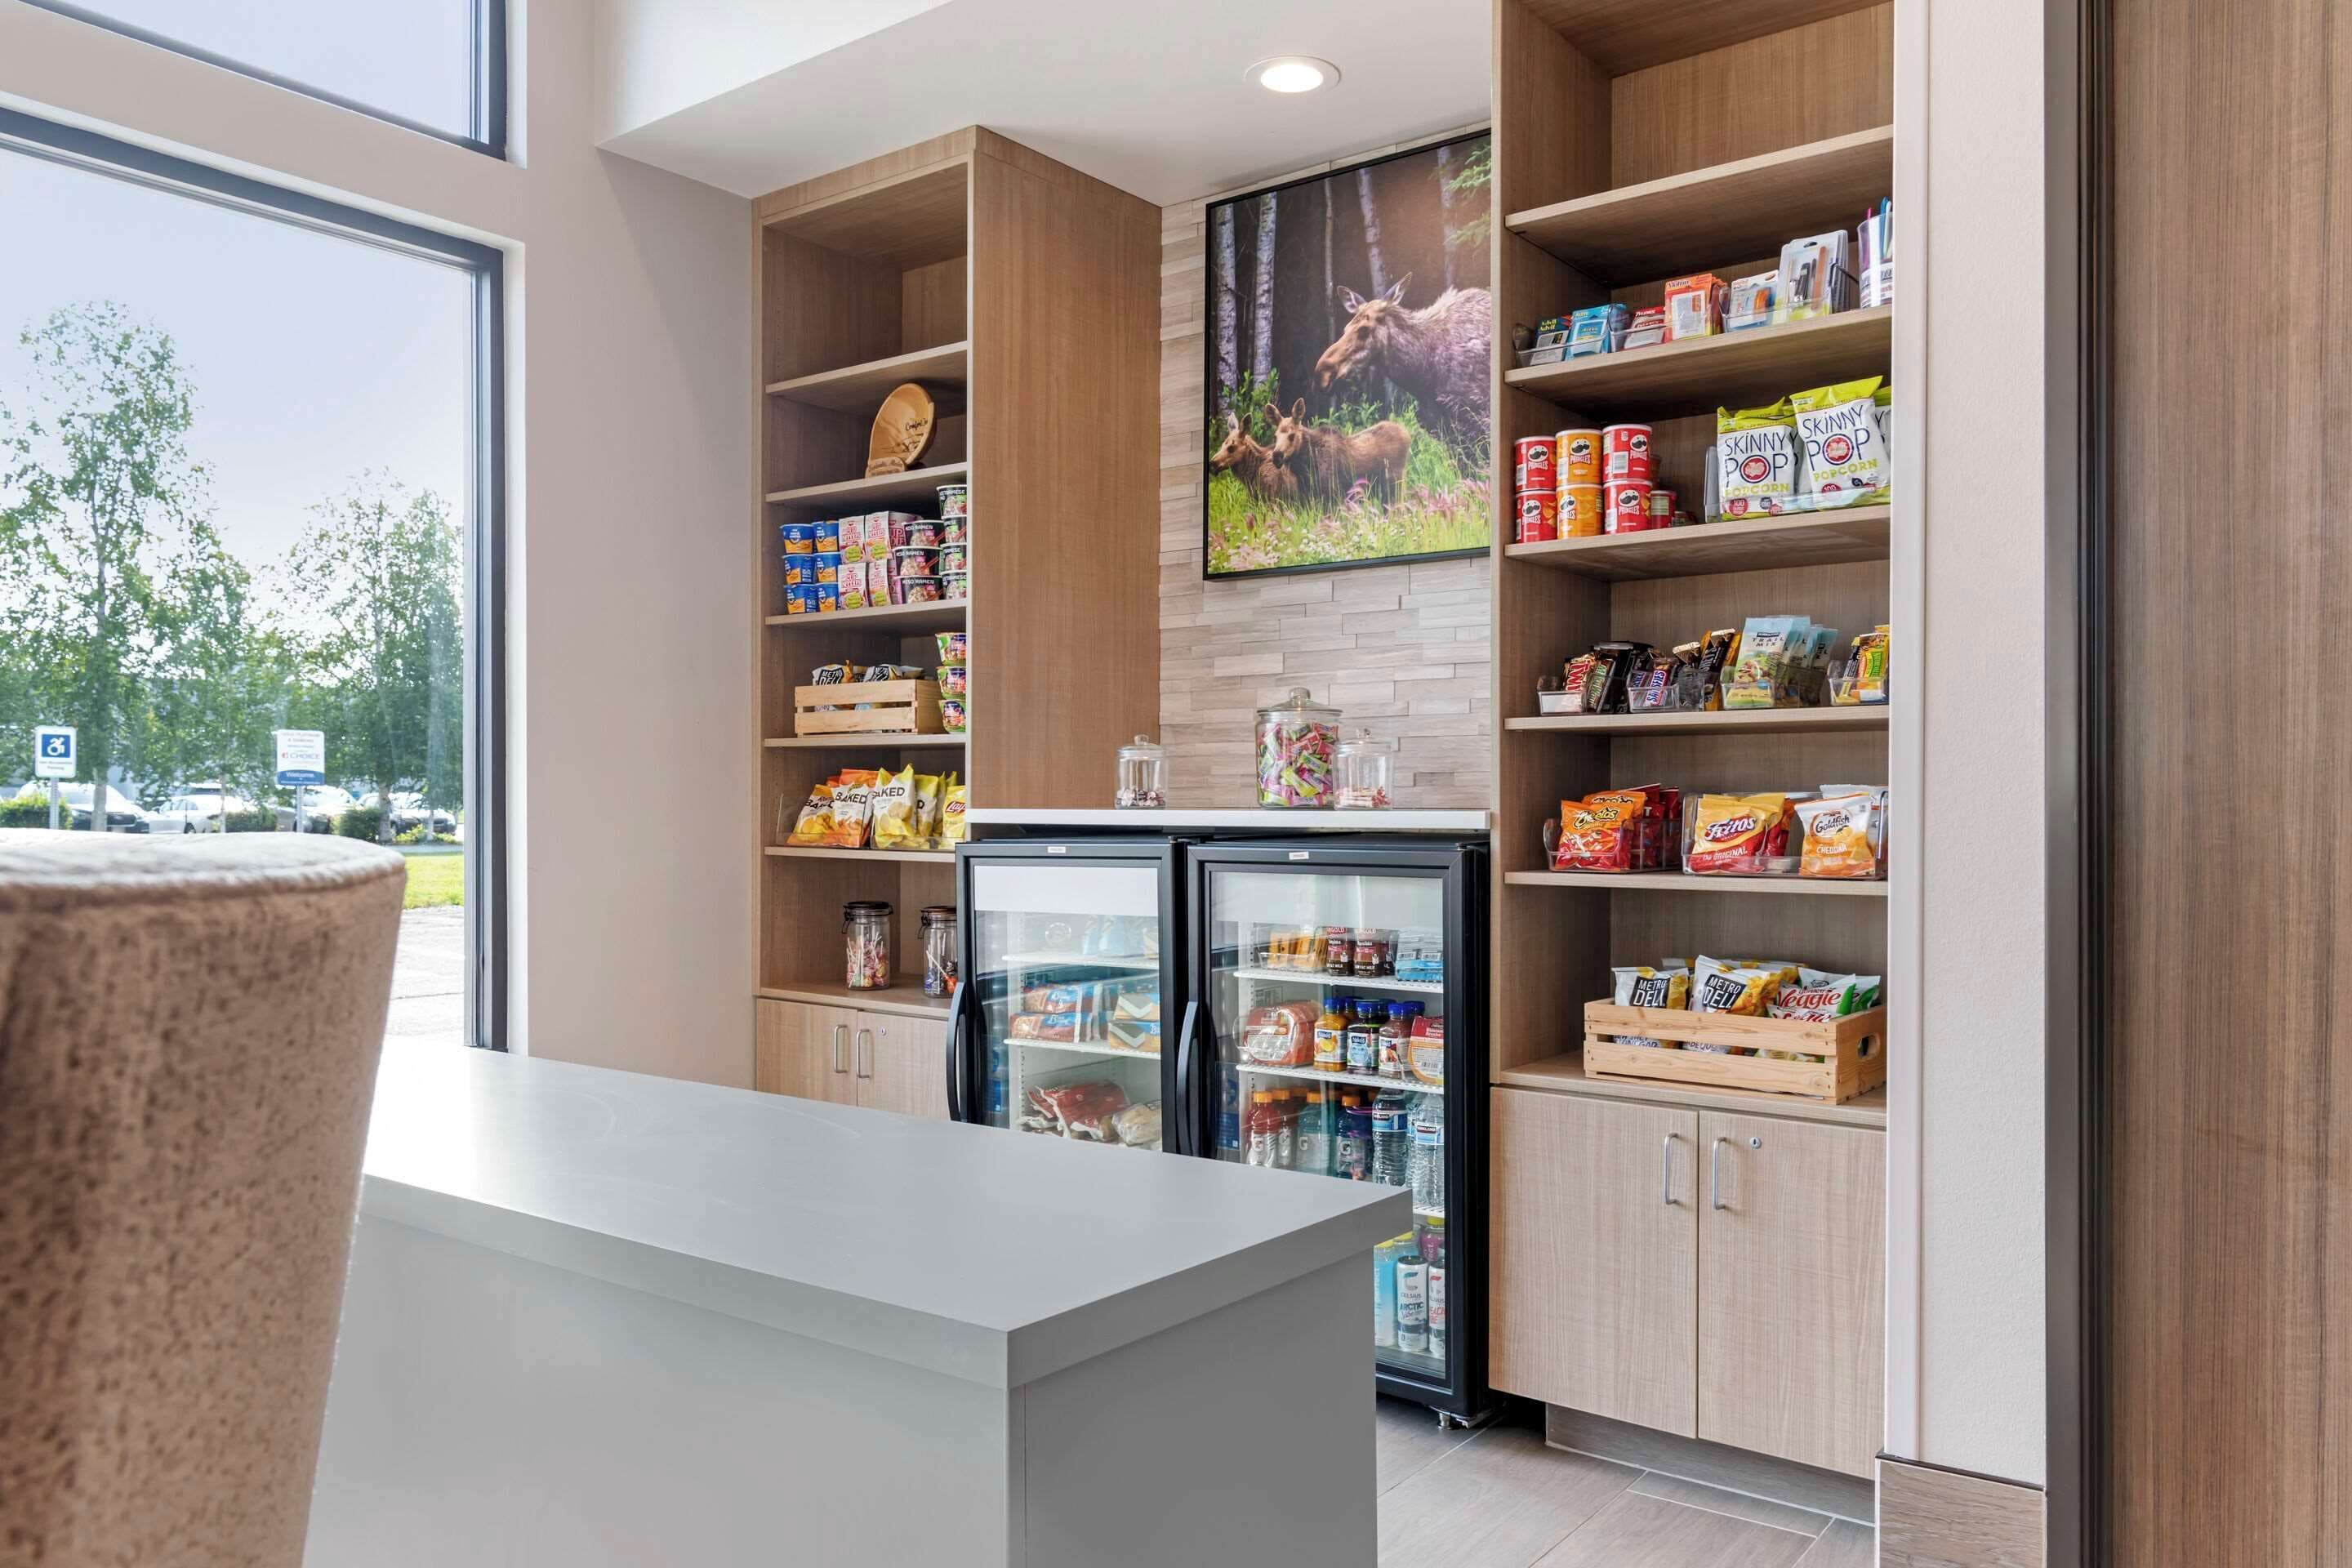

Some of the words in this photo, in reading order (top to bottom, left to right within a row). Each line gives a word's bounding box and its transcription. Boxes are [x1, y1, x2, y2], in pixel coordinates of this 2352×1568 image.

[1806, 427, 1870, 471] POP
[1725, 453, 1788, 488] POP
[1813, 458, 1878, 482] POPCORN
[1725, 483, 1789, 497] POPCORN
[1566, 658, 1591, 692] TWI
[835, 792, 866, 804] BAKED
[1704, 817, 1756, 840] Fritos
[1815, 815, 1850, 833] Goldfish
[1713, 847, 1748, 861] ORIGINAL
[1816, 843, 1847, 854] CHEDDAR
[1638, 979, 1667, 991] METRO
[1708, 976, 1741, 994] METRO
[1633, 989, 1665, 1007] DELI
[1703, 987, 1736, 1009] DELI
[1777, 989, 1841, 1009] Veggie
[1299, 1137, 1307, 1150] G
